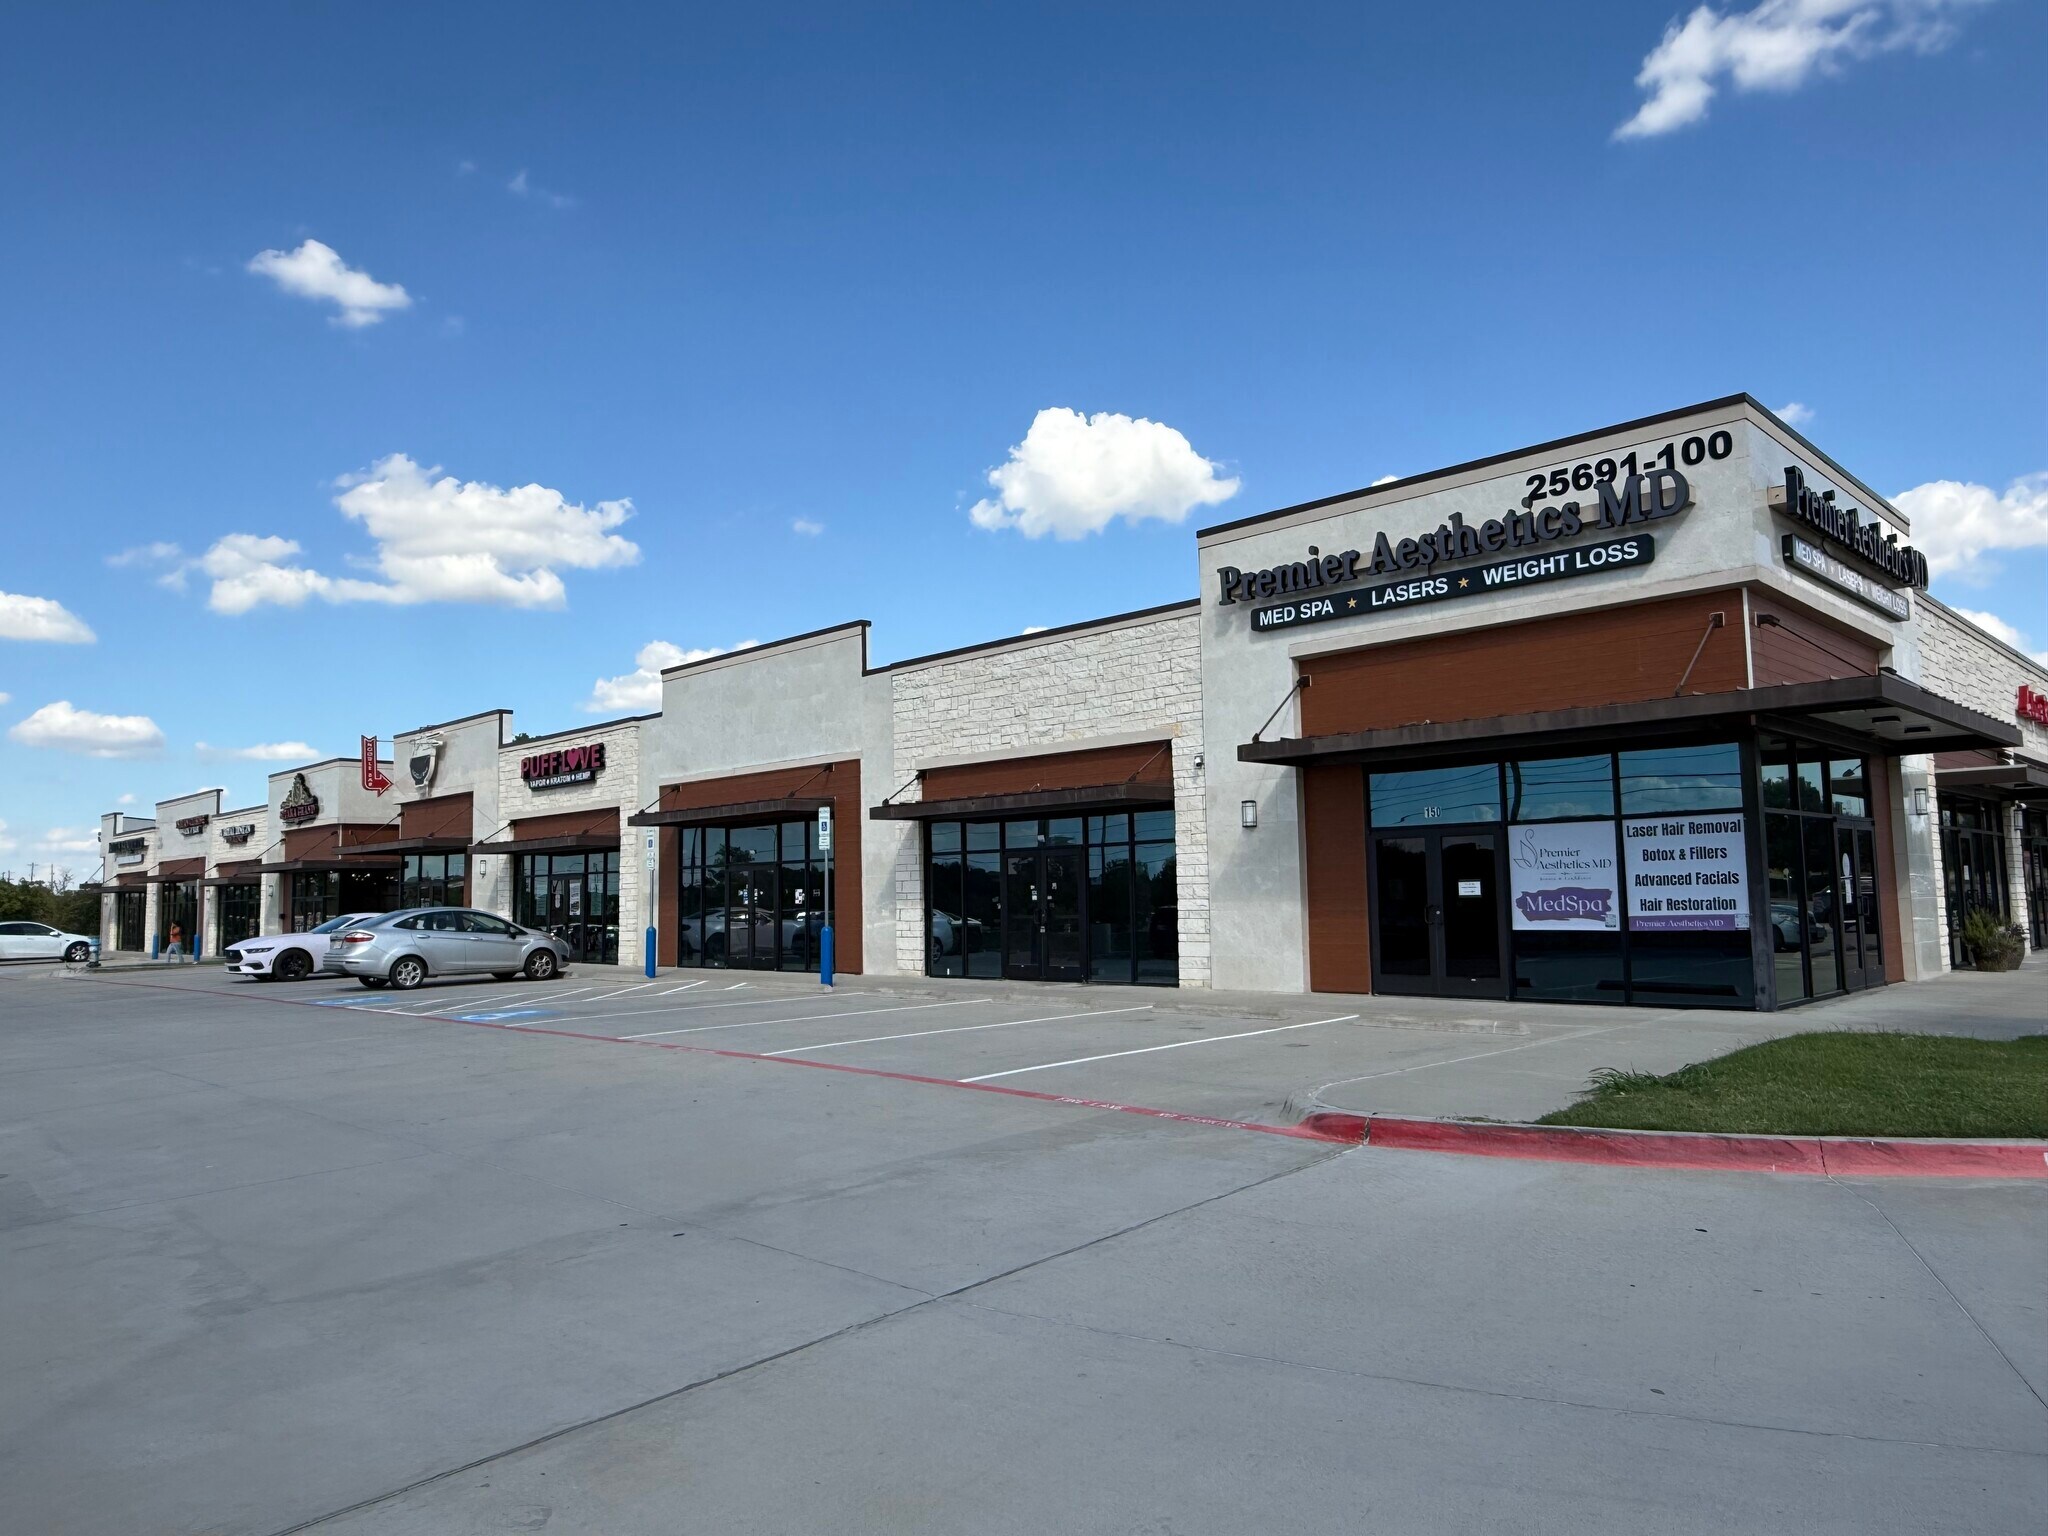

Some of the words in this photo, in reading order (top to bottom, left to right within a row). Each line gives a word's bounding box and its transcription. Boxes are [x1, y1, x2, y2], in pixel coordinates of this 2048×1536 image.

[1525, 430, 1733, 500] 25691-100
[1784, 465, 1850, 545] Premier
[1217, 546, 1360, 606] Premier
[1367, 497, 1581, 576] Aesthetics
[1594, 468, 1691, 531] MD
[1795, 540, 1812, 564] MED
[1812, 551, 1827, 573] SPA
[1838, 565, 1863, 593] LASERS
[1258, 603, 1296, 627] MED
[1299, 599, 1334, 621] SPA
[1371, 577, 1449, 607] LASERS
[1482, 553, 1571, 585] WEIGHT
[1576, 541, 1640, 569] LOSS
[521, 751, 560, 779] PUFF
[1424, 806, 1441, 819] 150
[1626, 825, 1658, 838] Laser
[1661, 822, 1685, 836] Hair
[1688, 819, 1742, 835] Removal
[1539, 848, 1581, 858] Premier
[1642, 848, 1676, 862] Botox
[1678, 848, 1687, 861] &
[1689, 846, 1728, 860] Fillers
[1537, 860, 1591, 870] Aesthetics
[1592, 858, 1612, 869] MD
[1634, 872, 1692, 887] Advanced
[1695, 871, 1740, 885] Facials
[1526, 894, 1603, 916] MedSpa
[1639, 898, 1664, 912] Hair
[1666, 897, 1737, 911] Restoration
[1636, 920, 1666, 928] Premier
[1667, 919, 1708, 928] Aesthetics
[1709, 919, 1724, 927] MD
